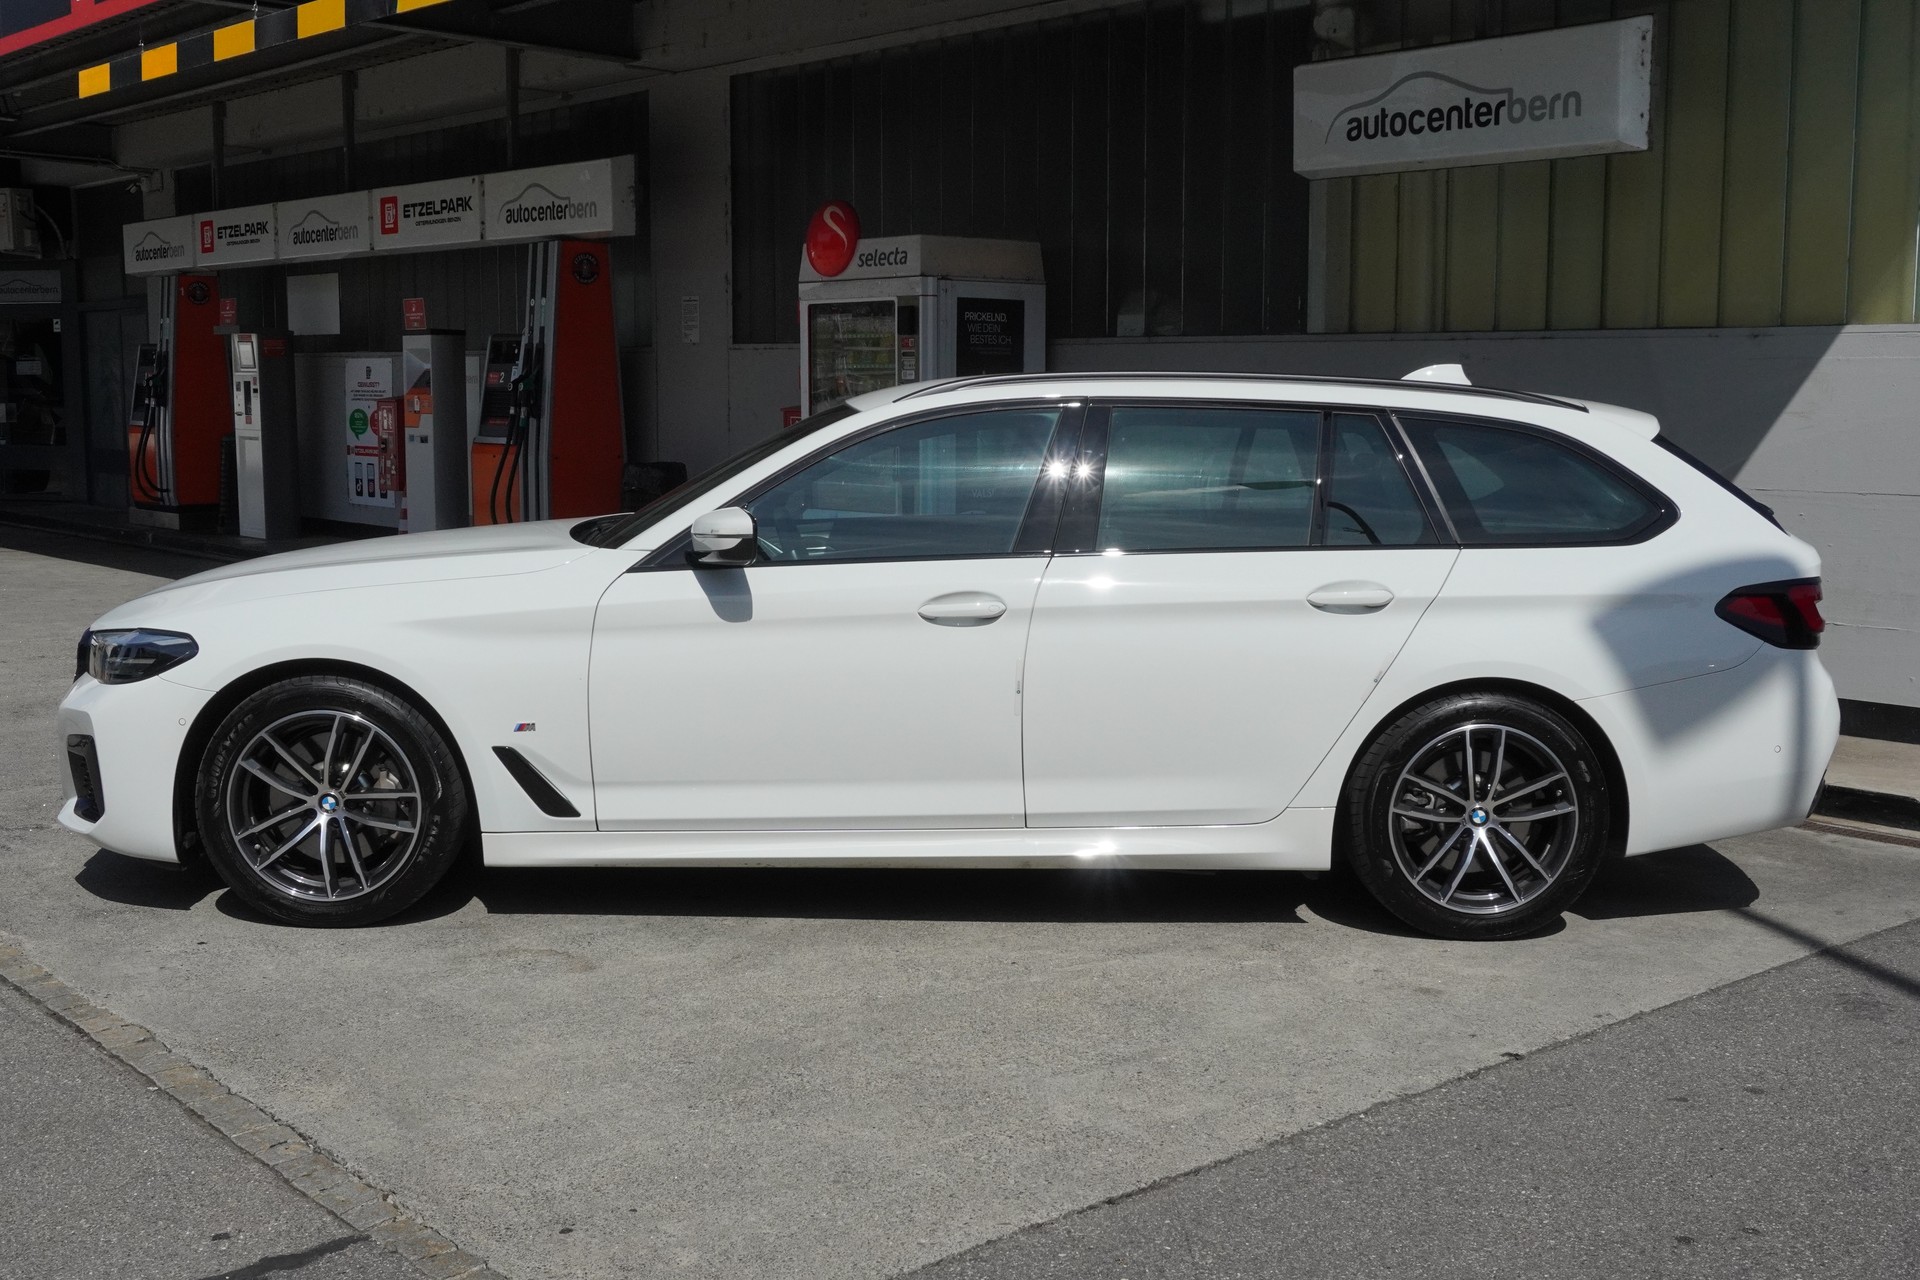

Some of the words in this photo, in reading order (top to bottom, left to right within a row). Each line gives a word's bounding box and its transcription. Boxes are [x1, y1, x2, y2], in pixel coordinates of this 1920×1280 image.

[403, 196, 473, 218] ETZELPARK
[217, 221, 269, 239] ETZELPARK
[857, 248, 908, 267] selecta
[964, 311, 1008, 323] PRICKELND,
[968, 323, 981, 333] WIE
[982, 323, 1001, 333] DEIN
[970, 334, 998, 344] BESTES
[499, 371, 505, 383] 2
